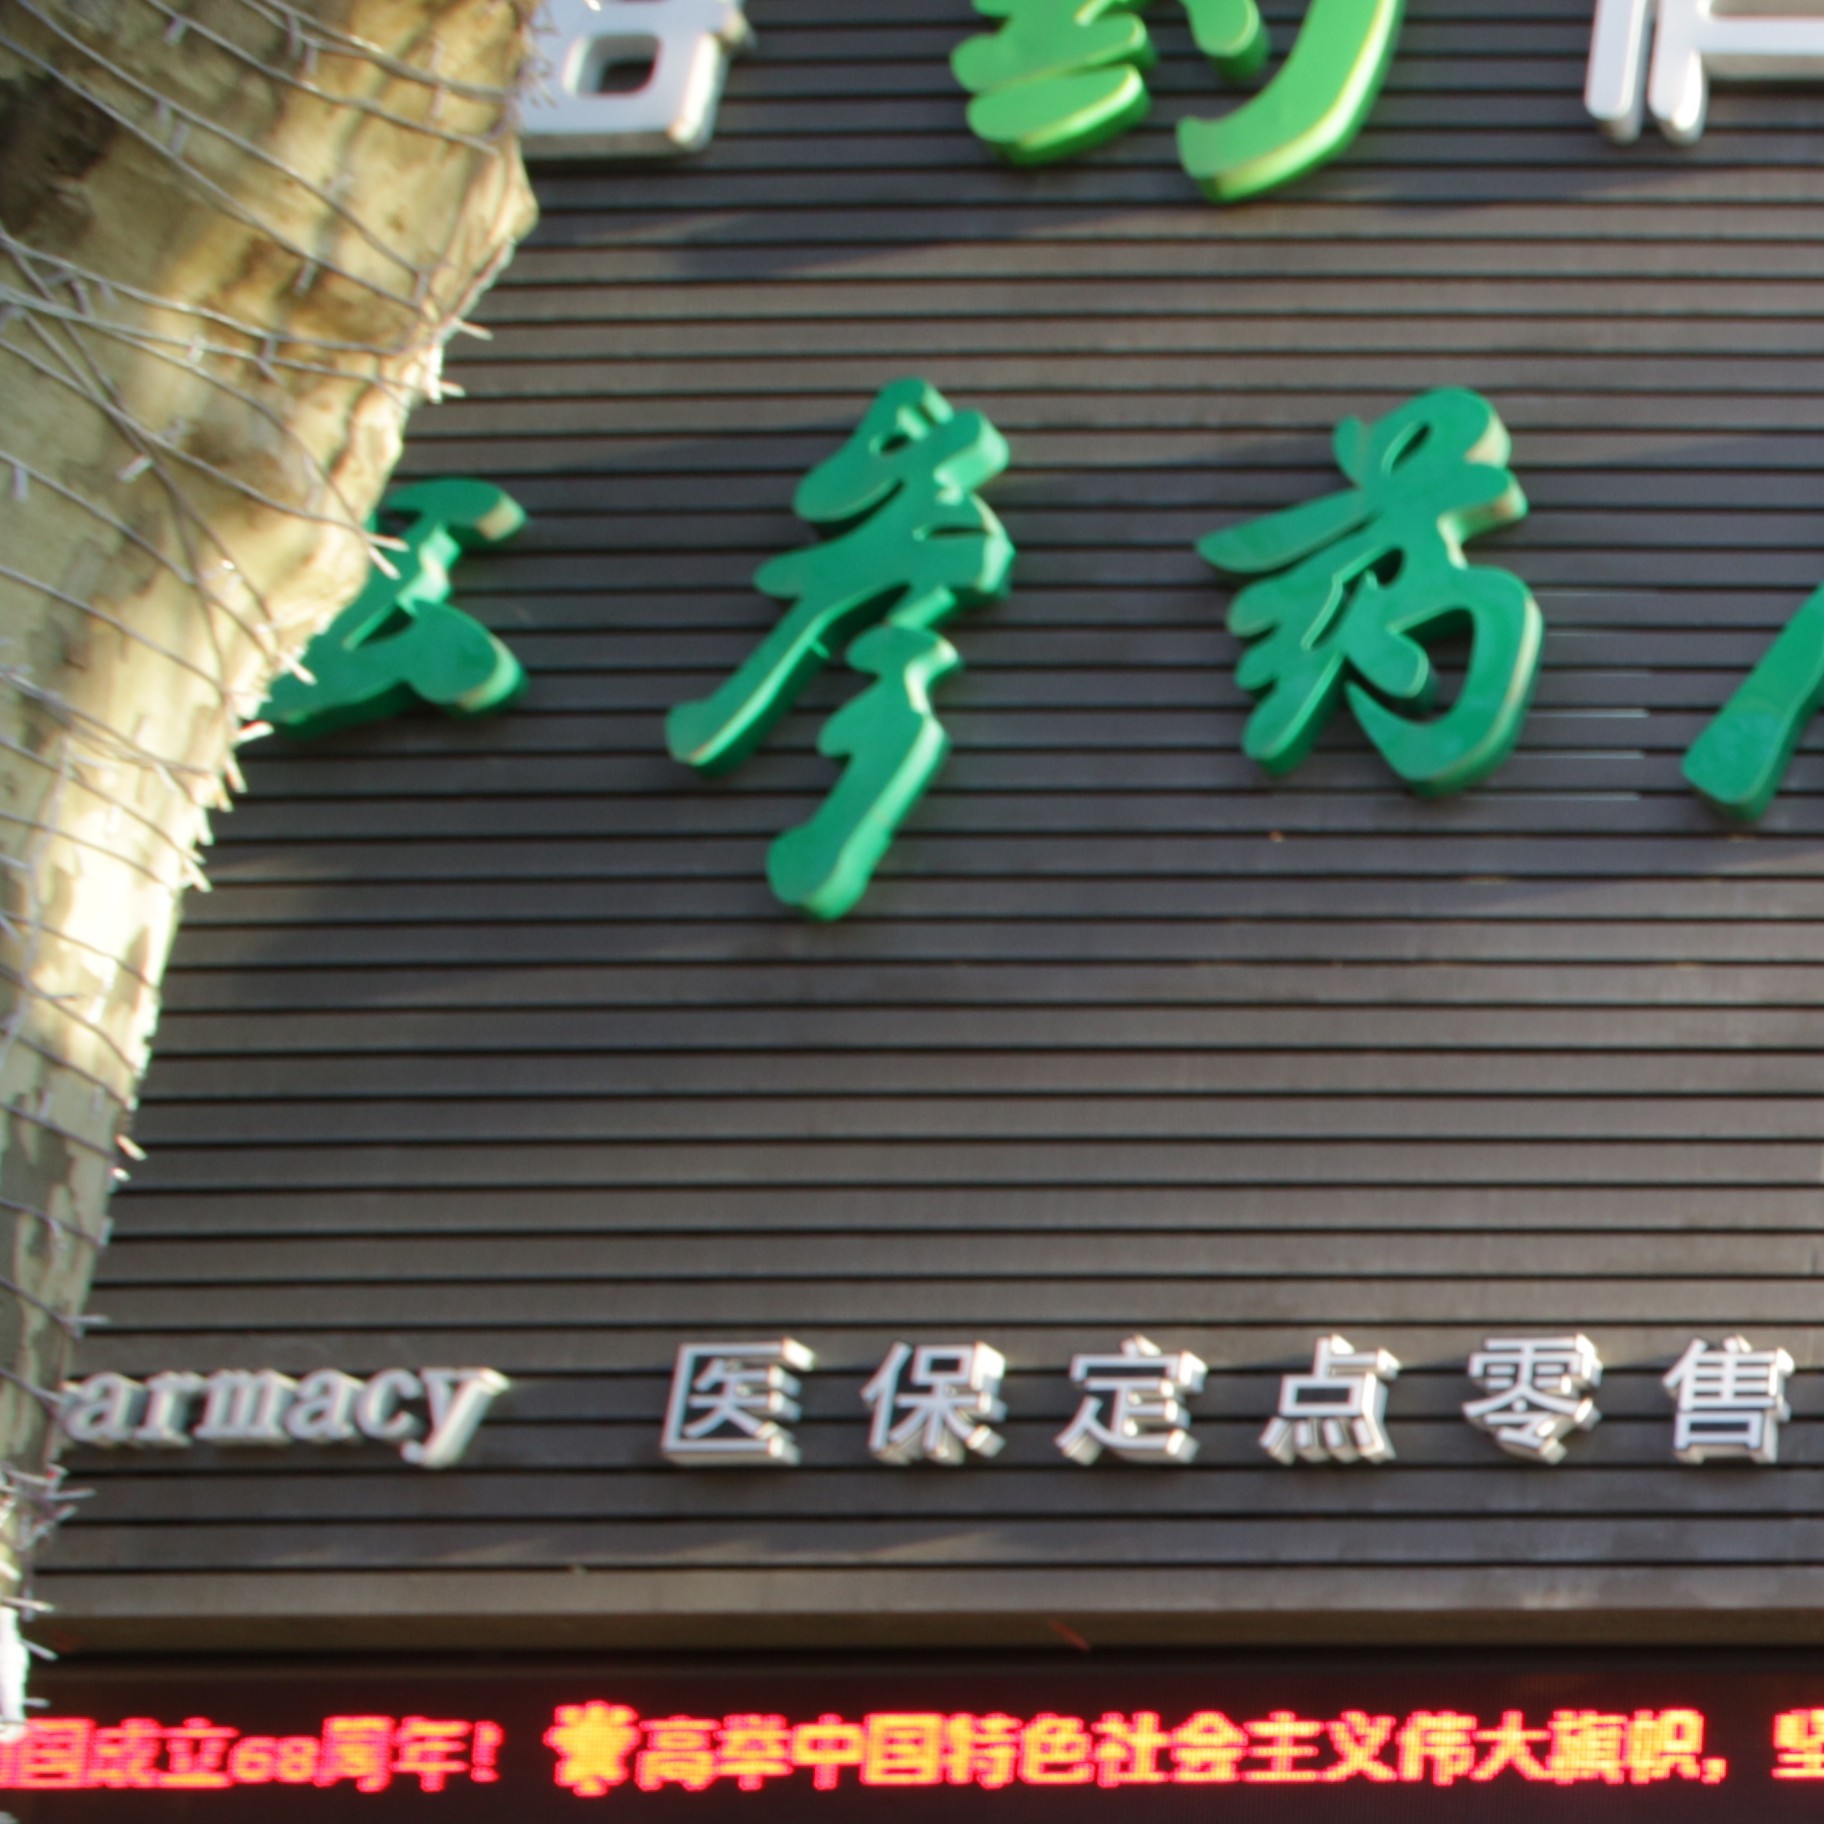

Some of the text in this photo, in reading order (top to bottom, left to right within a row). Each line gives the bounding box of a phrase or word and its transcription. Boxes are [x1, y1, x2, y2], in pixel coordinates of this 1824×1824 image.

[0, 1713, 504, 1793] 国成立68周年！
